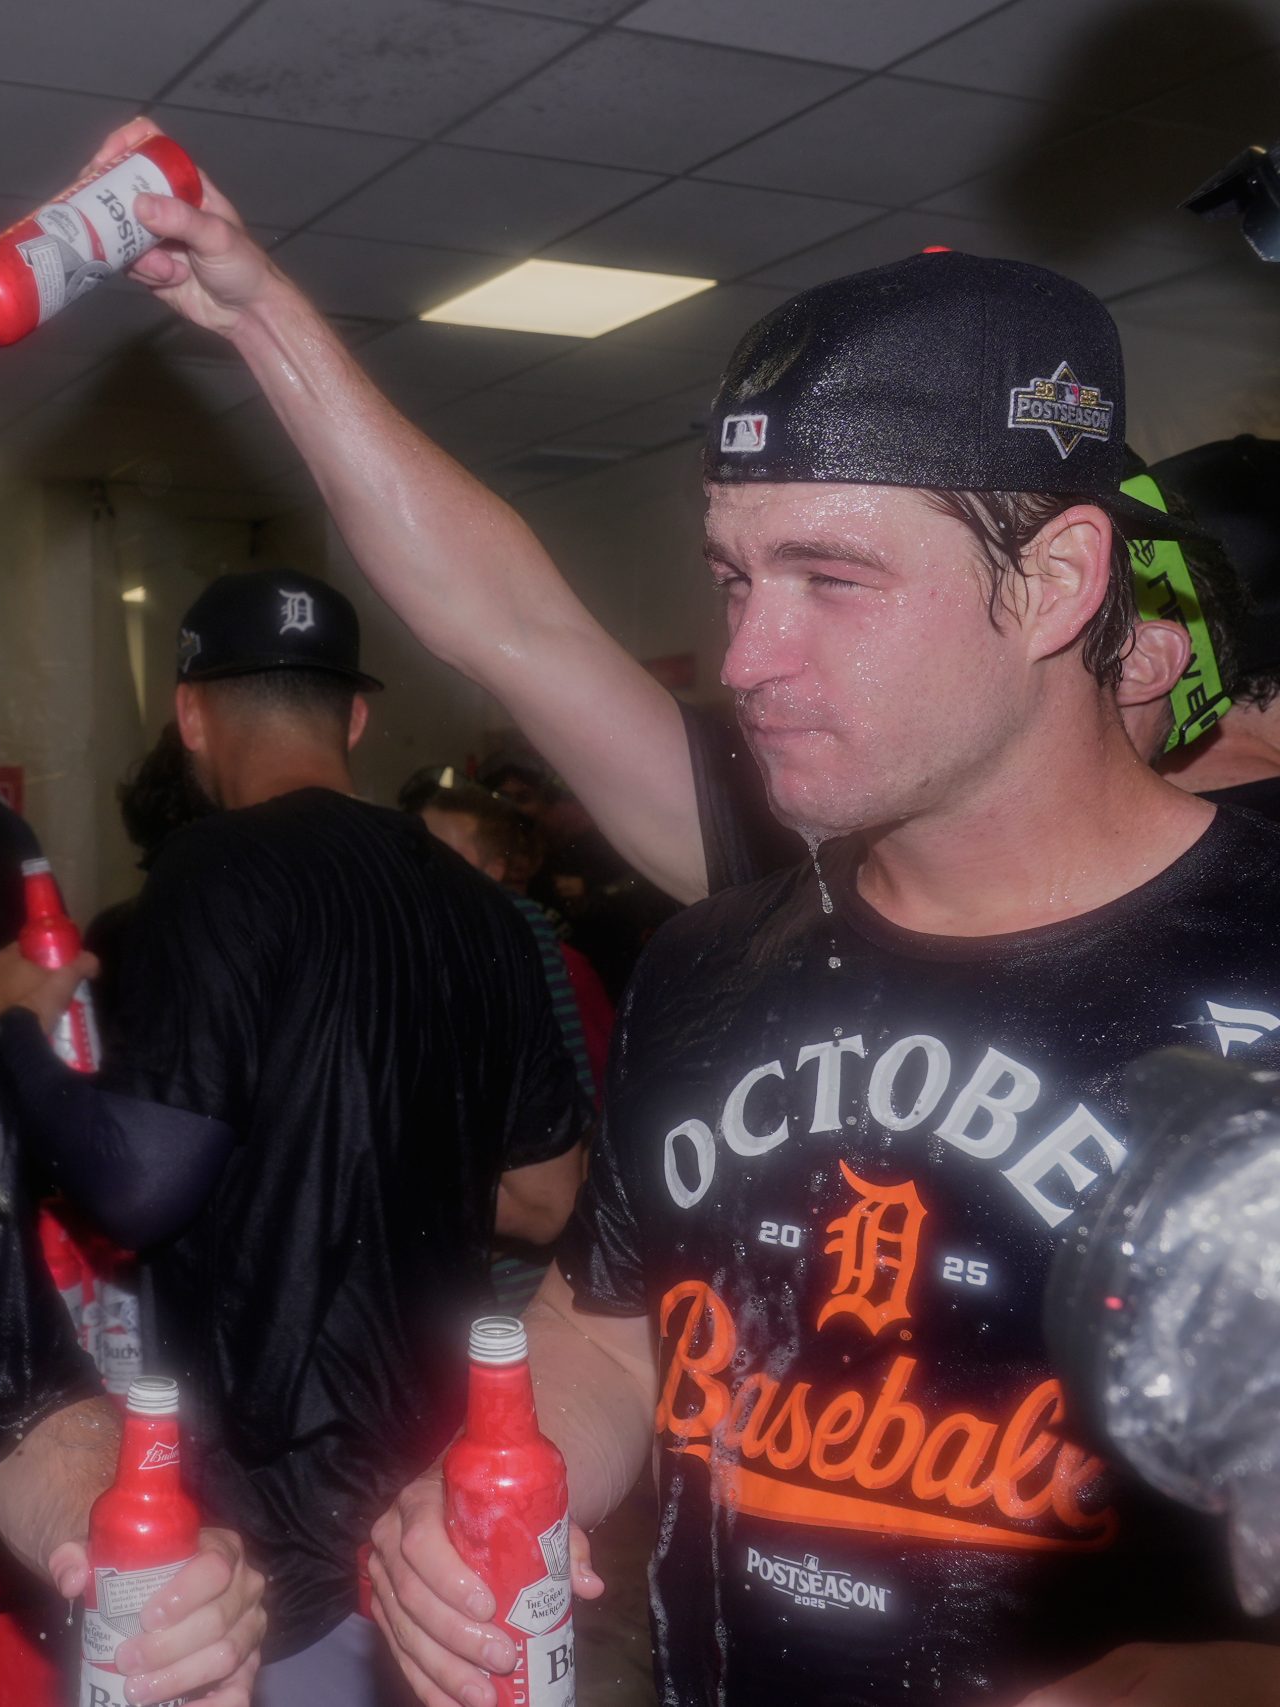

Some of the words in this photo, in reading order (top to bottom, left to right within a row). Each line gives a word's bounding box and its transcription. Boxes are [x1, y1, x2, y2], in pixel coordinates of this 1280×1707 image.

[1016, 398, 1111, 429] POSTSEASON
[279, 588, 316, 636] D
[663, 1034, 1129, 1229] OCTOBE
[758, 1220, 802, 1249] 20
[942, 1255, 990, 1287] 25
[525, 1599, 542, 1610] THE
[542, 1587, 565, 1605] GREAT
[746, 1546, 887, 1613] POSTSEASON
[531, 1597, 566, 1620] AMERICAN
[794, 1594, 827, 1610] 2025
